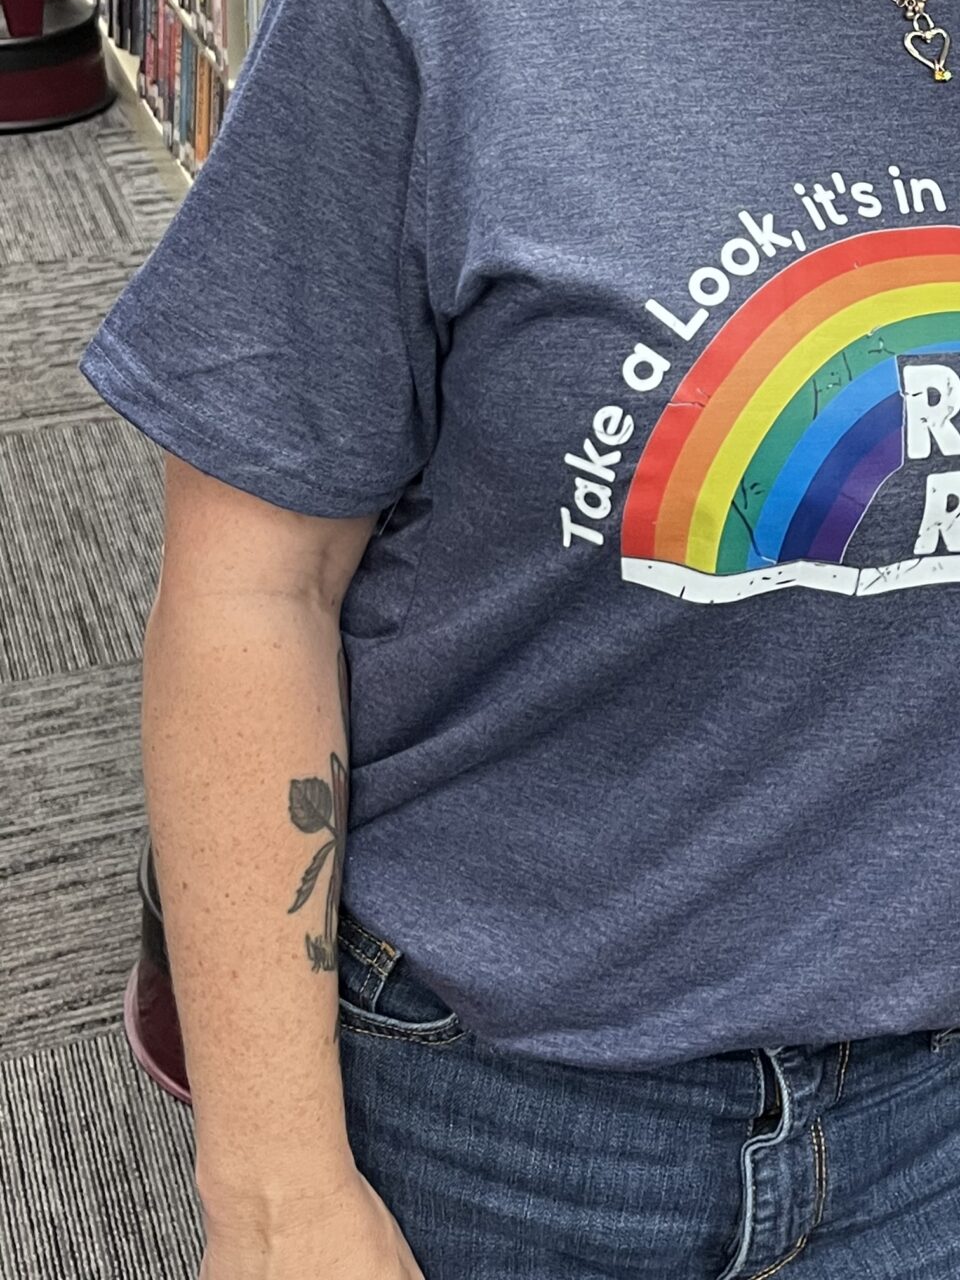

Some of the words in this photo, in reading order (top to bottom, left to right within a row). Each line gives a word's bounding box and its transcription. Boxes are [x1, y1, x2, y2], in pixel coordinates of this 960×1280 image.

[794, 170, 884, 233] it's
[890, 165, 948, 214] in
[646, 209, 808, 342] Look,
[622, 342, 672, 393] a
[561, 404, 636, 549] Take
